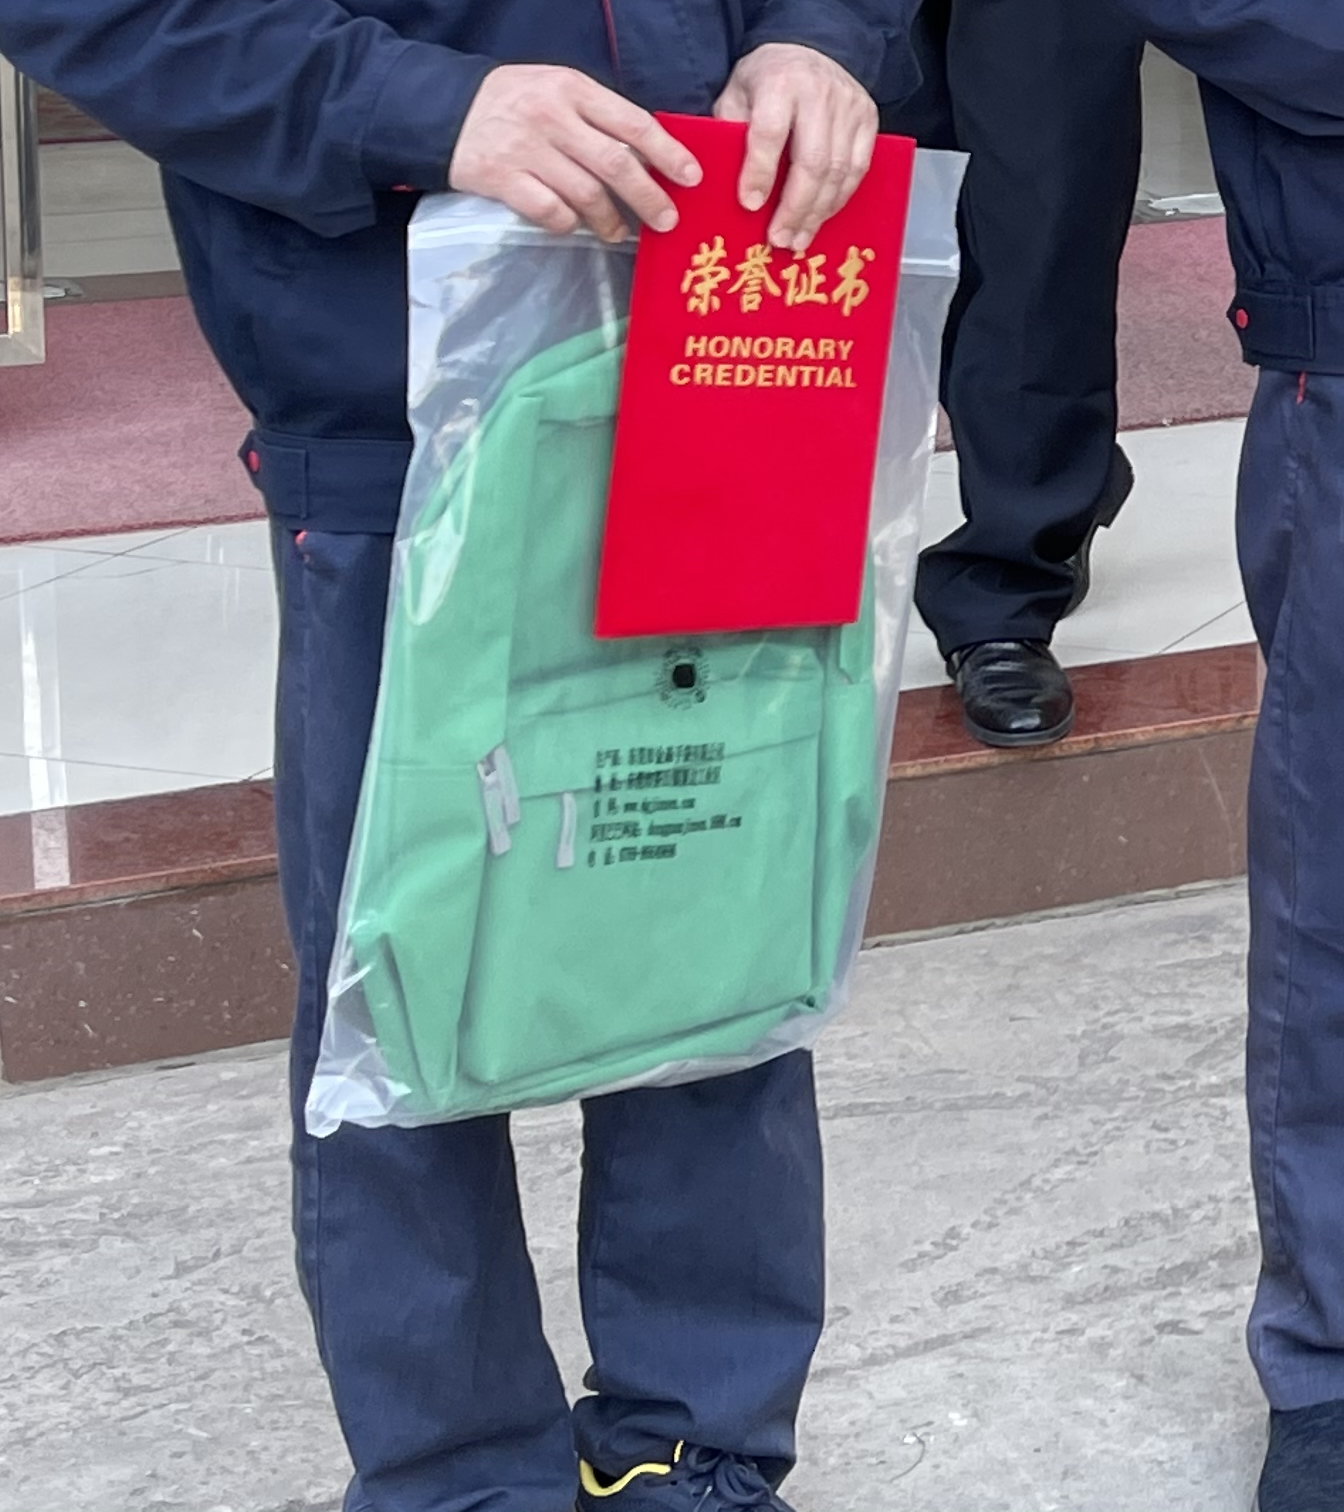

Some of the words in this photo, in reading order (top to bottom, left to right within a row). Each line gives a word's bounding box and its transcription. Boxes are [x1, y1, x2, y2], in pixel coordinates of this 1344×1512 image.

[680, 236, 876, 317] 荣誉证书
[685, 336, 854, 361] HONORARY
[669, 364, 857, 387] CREDENTIAL
